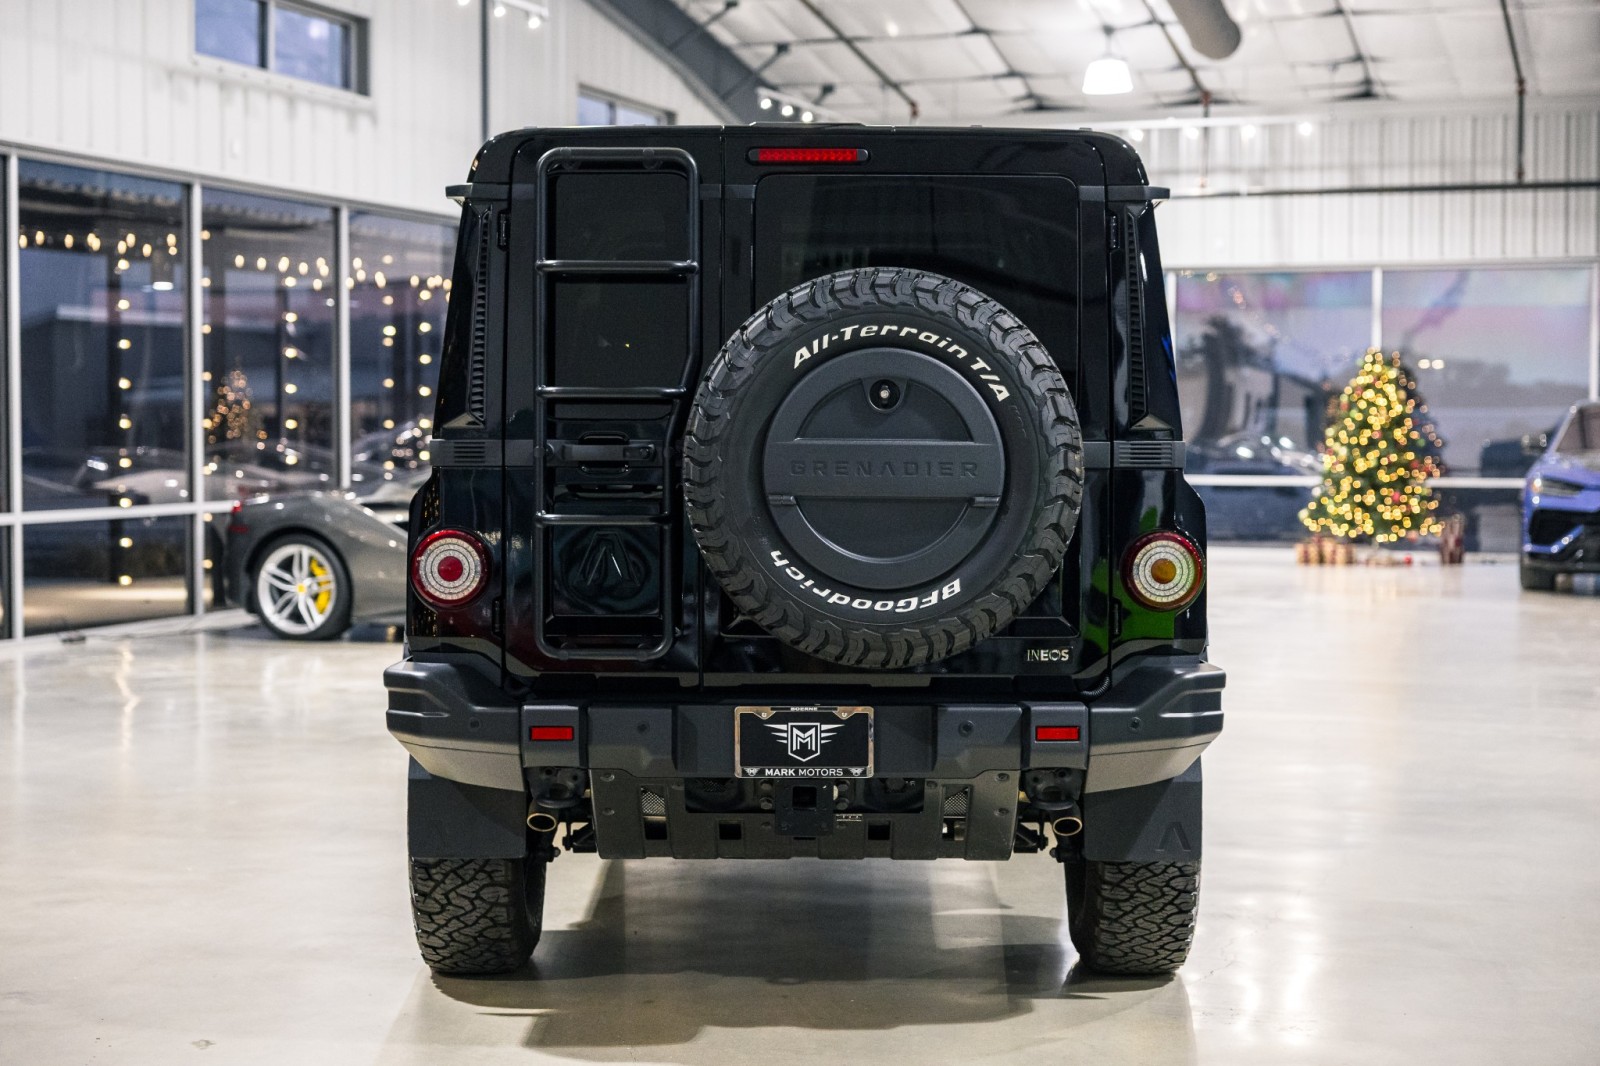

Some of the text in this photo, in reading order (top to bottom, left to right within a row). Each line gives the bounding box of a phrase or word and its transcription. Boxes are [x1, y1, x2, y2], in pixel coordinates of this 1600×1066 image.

[793, 322, 1011, 402] All-Terrain T/A
[790, 460, 978, 478] GRENADIER
[769, 550, 962, 613] BFGoodrich
[1027, 649, 1070, 661] INEOS
[765, 768, 844, 777] MARK MOTORS
